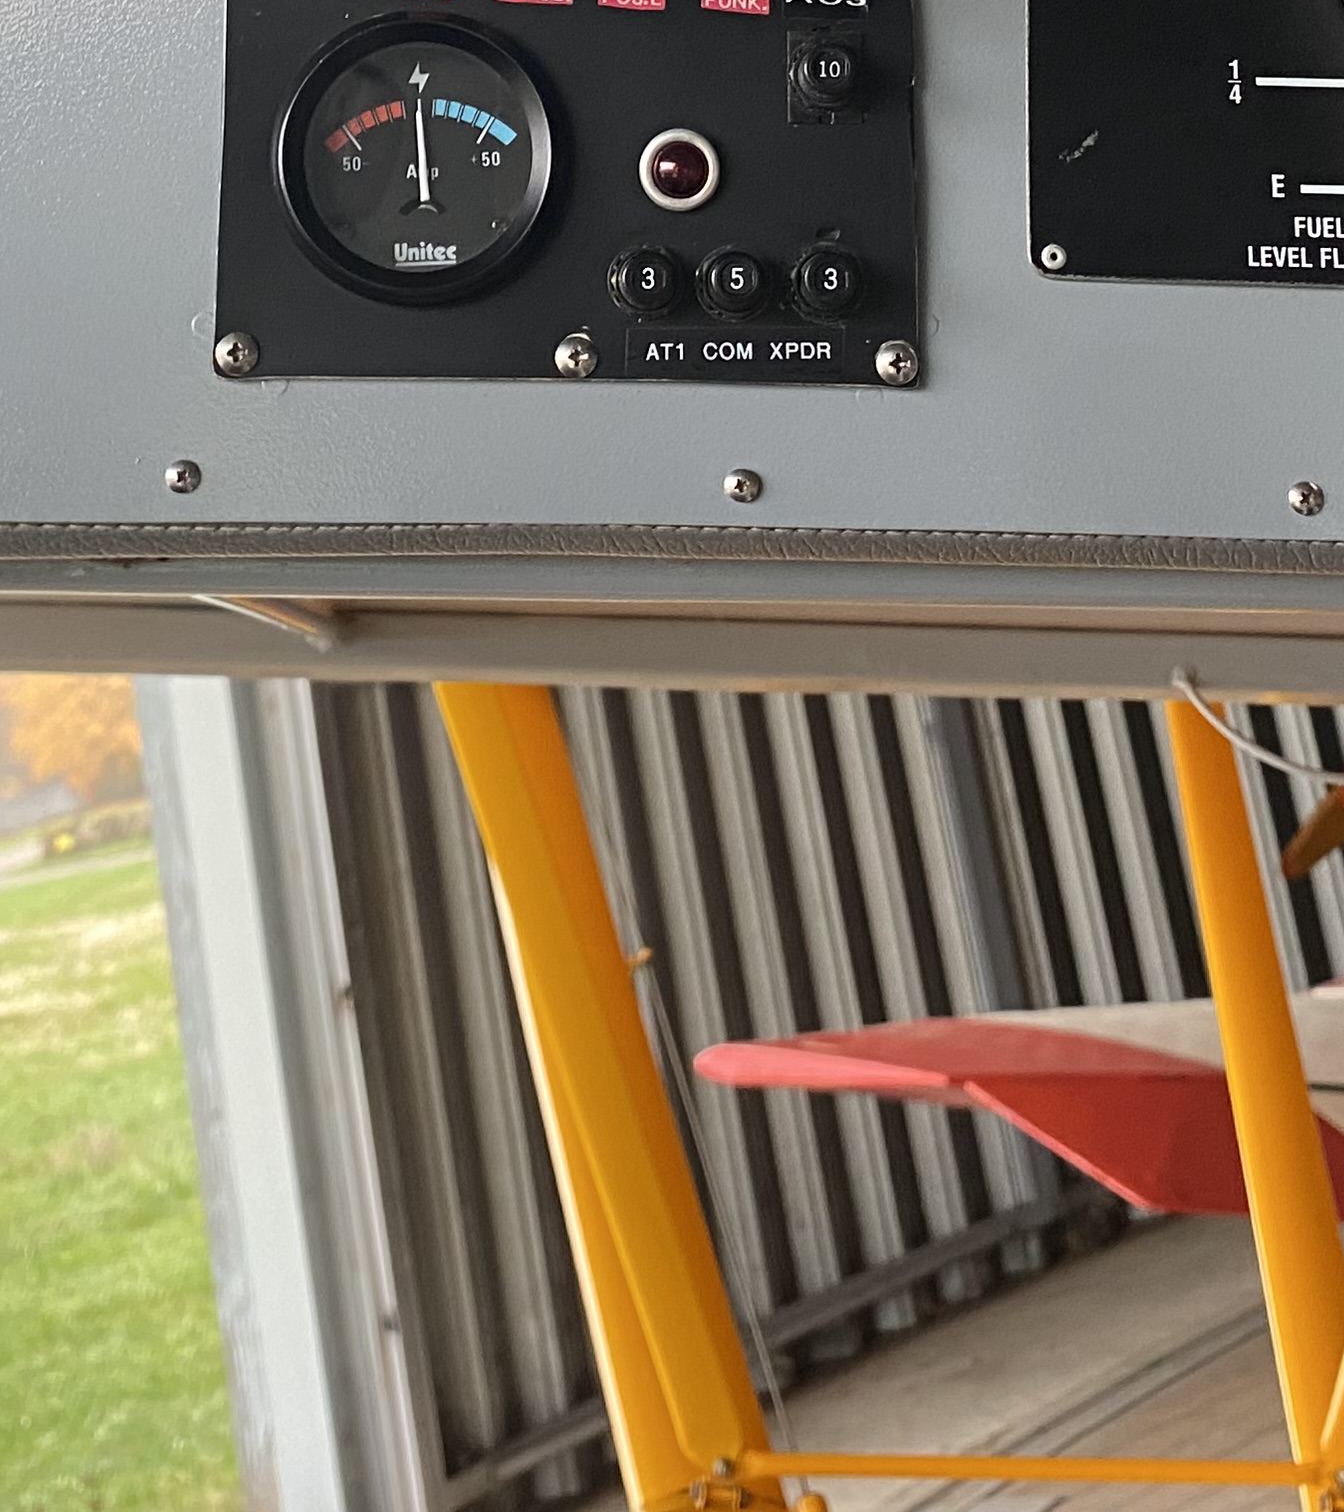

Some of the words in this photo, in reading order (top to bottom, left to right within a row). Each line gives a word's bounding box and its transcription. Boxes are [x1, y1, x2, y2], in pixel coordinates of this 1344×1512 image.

[819, 60, 841, 78] 10
[406, 163, 439, 180] Ap
[1271, 173, 1286, 198] E
[393, 240, 458, 263] Unitec
[1247, 245, 1314, 268] LEVEL
[641, 267, 656, 290] 3
[730, 267, 744, 290] 5
[823, 267, 838, 290] 3
[645, 342, 685, 362] AT1
[702, 341, 754, 362] COM
[769, 341, 832, 361] XPDR
